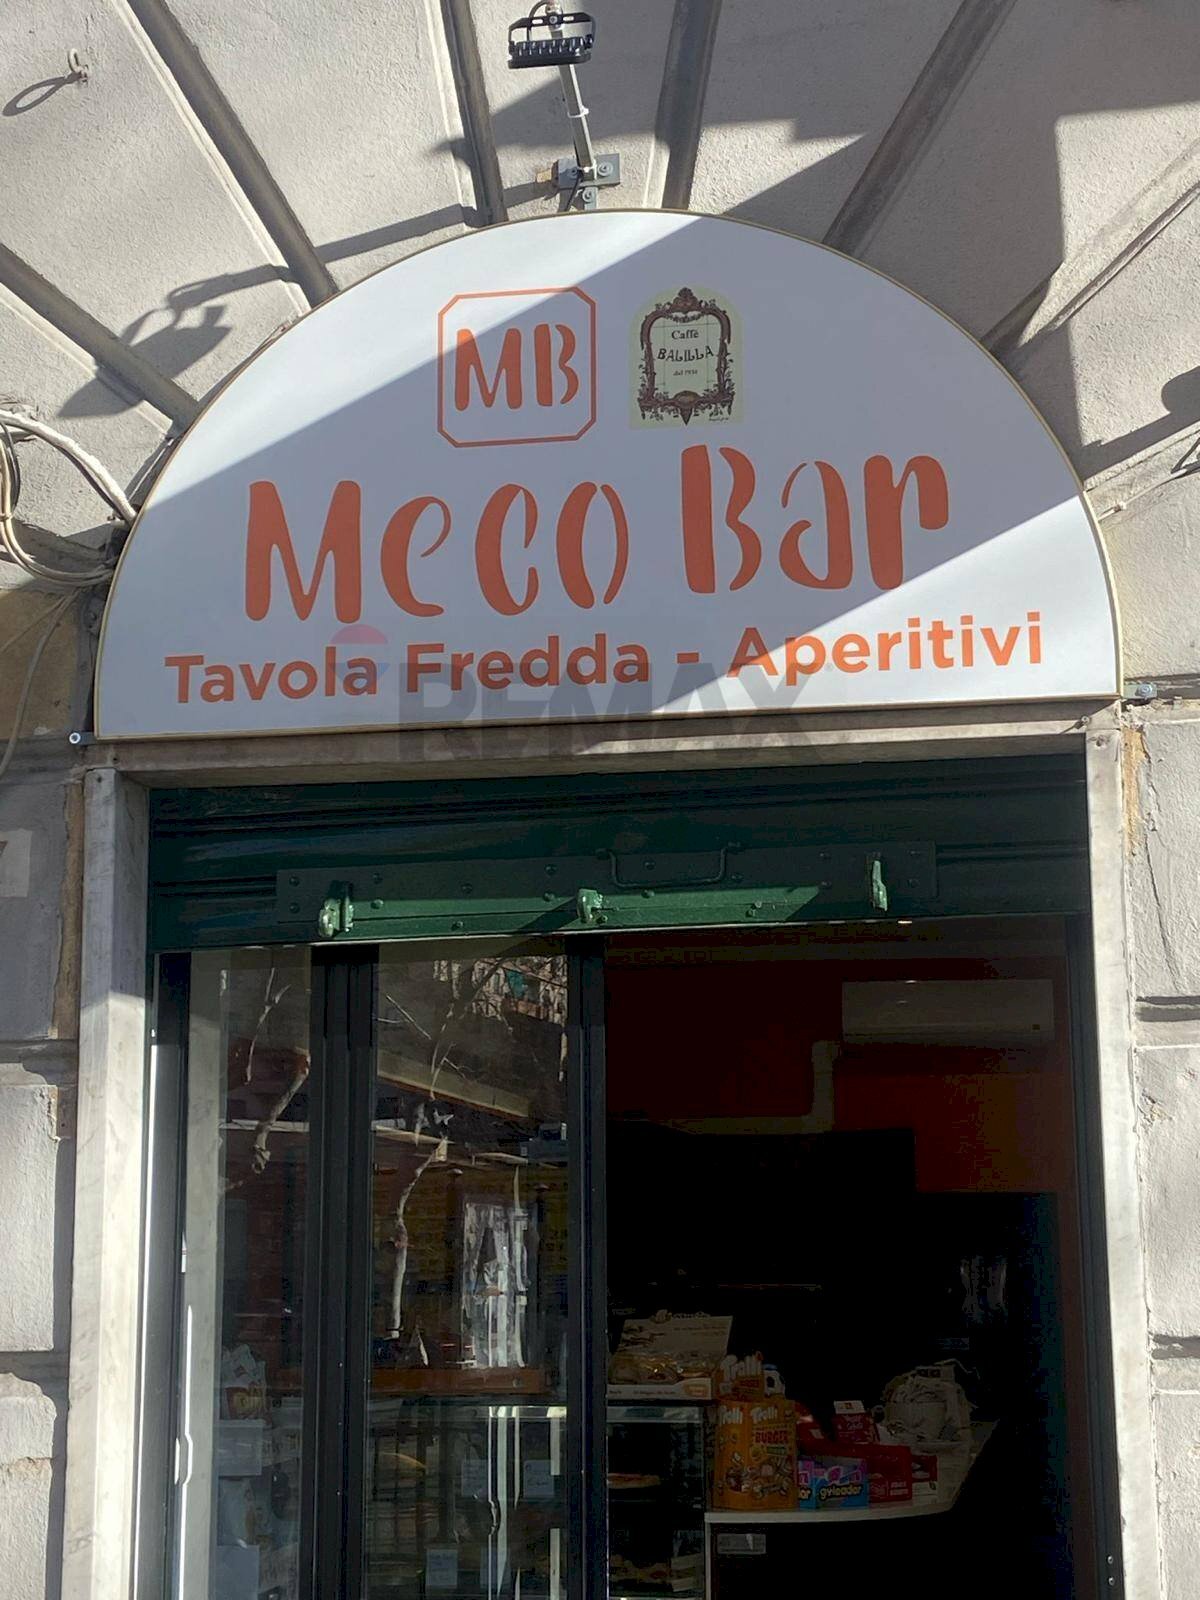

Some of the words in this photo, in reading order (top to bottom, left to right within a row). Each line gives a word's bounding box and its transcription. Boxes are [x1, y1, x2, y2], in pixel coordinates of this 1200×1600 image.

[456, 324, 594, 410] MB
[657, 345, 714, 362] BALILLA
[671, 329, 699, 340] Caffè
[682, 445, 949, 593] Bar
[165, 646, 378, 703] Tavola
[407, 634, 650, 692] Fredda
[726, 610, 1044, 687] Aperitivi
